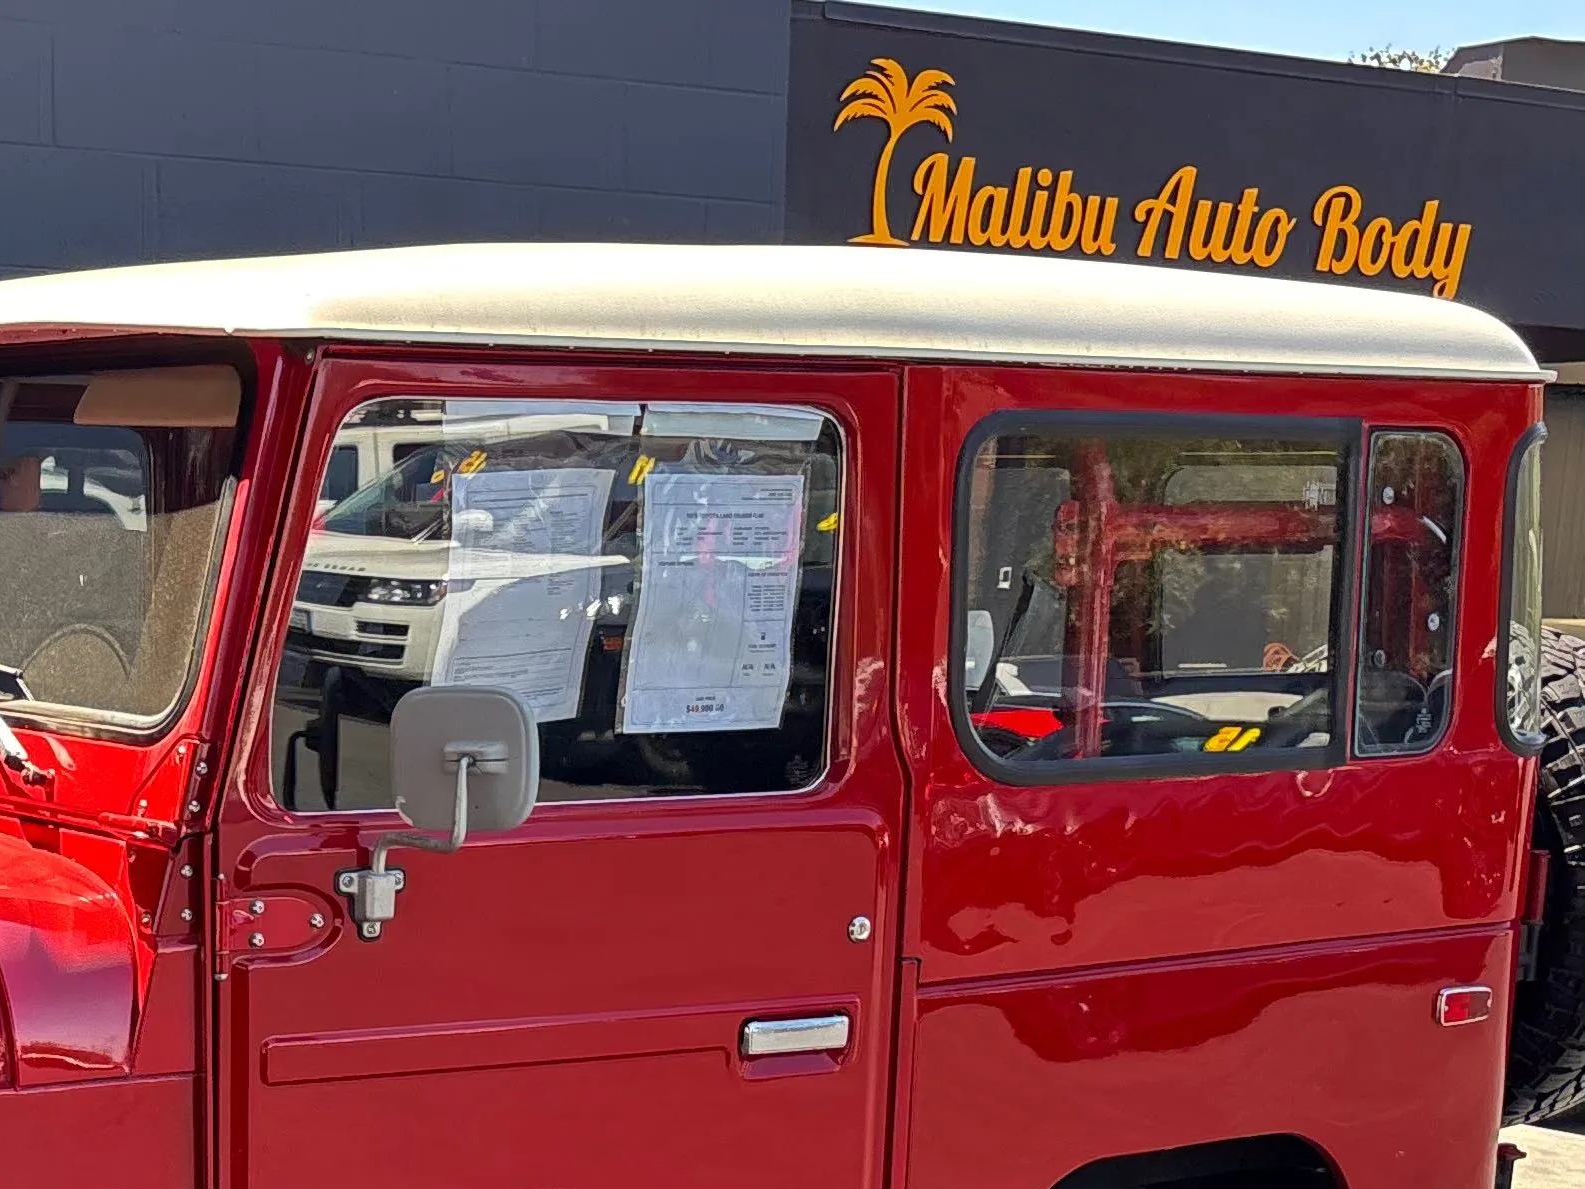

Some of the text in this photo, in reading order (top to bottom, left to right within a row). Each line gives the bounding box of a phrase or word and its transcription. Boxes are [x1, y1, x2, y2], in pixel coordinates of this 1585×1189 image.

[911, 152, 1472, 300] Malibu Auto Body
